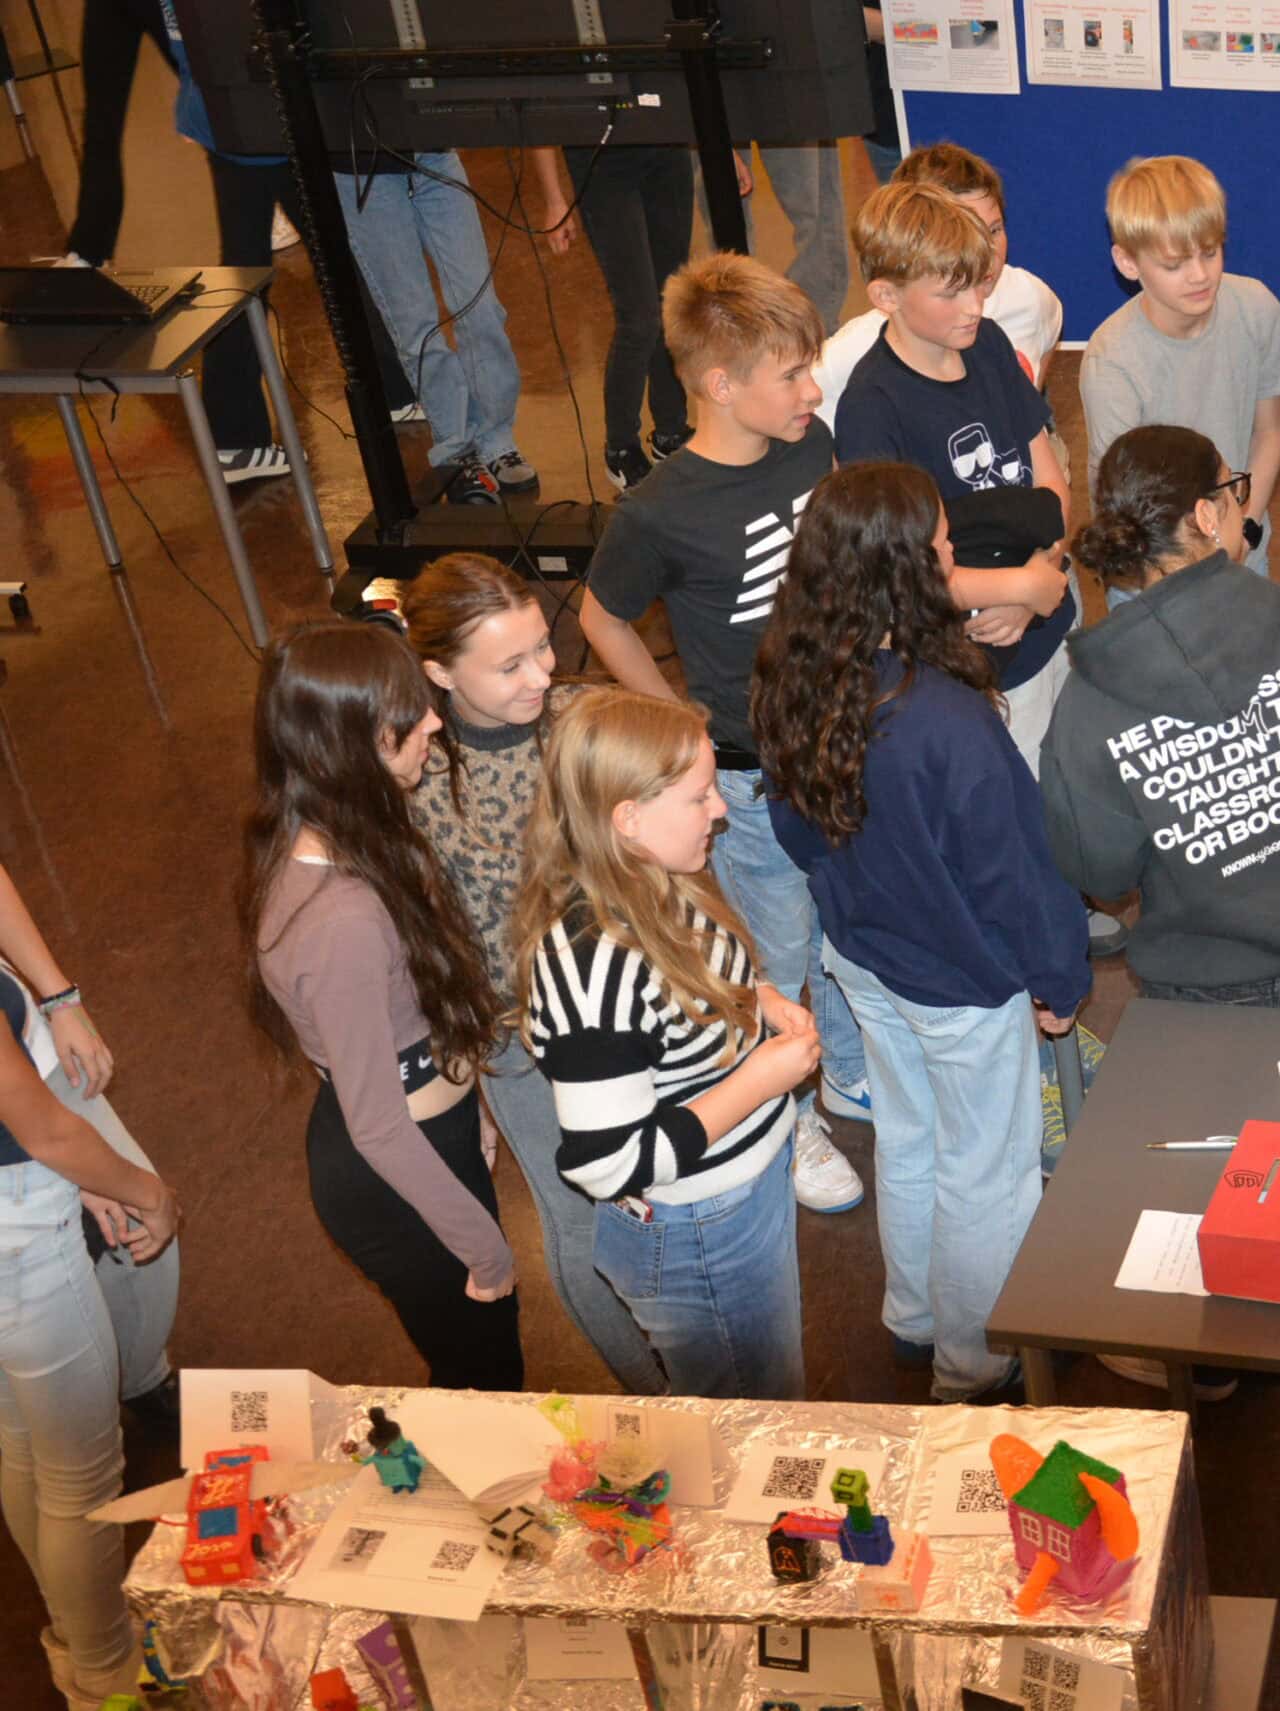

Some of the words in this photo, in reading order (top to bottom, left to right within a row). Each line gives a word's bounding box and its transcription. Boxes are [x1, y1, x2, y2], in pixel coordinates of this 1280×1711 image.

[1106, 724, 1152, 759] HE
[1119, 761, 1142, 783] A
[1185, 830, 1227, 865] OR
